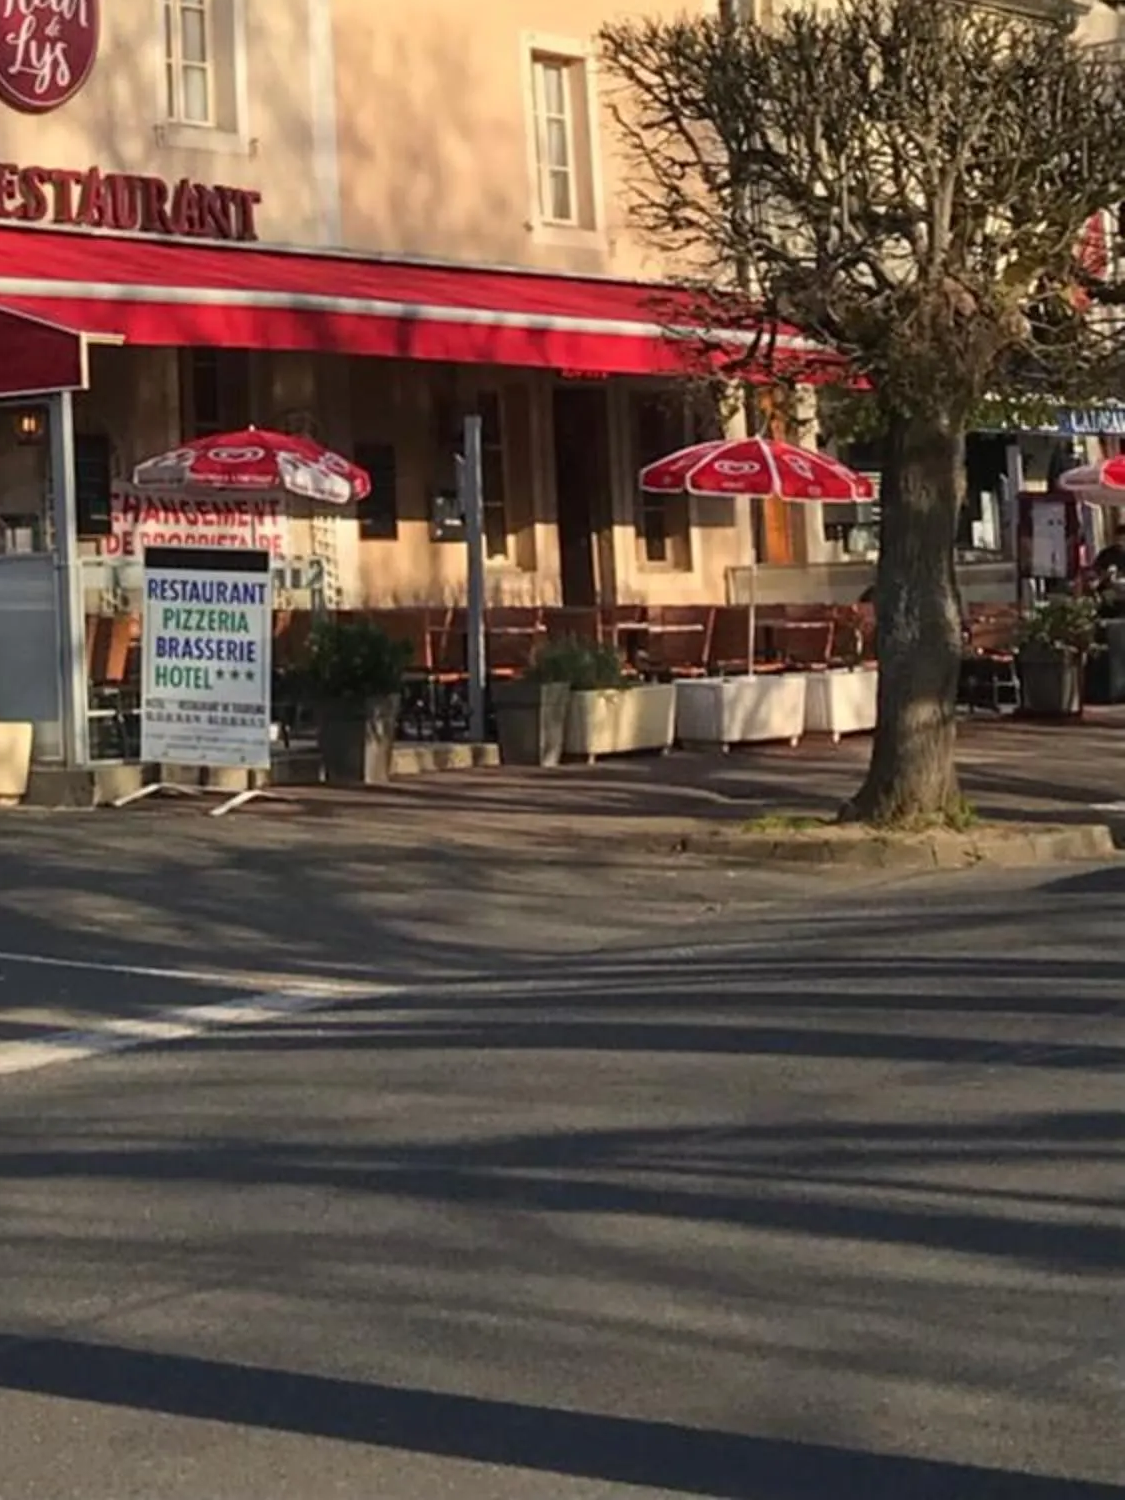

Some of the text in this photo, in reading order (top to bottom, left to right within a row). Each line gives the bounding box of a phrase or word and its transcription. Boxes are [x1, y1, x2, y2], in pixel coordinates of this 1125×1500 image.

[5, 15, 71, 93] Lys
[106, 532, 134, 556] DE
[148, 578, 267, 604] RESTAURANT
[162, 607, 250, 633] PIZZERIA
[156, 636, 256, 663] BRASSERIE
[155, 665, 213, 690] HOTEL
